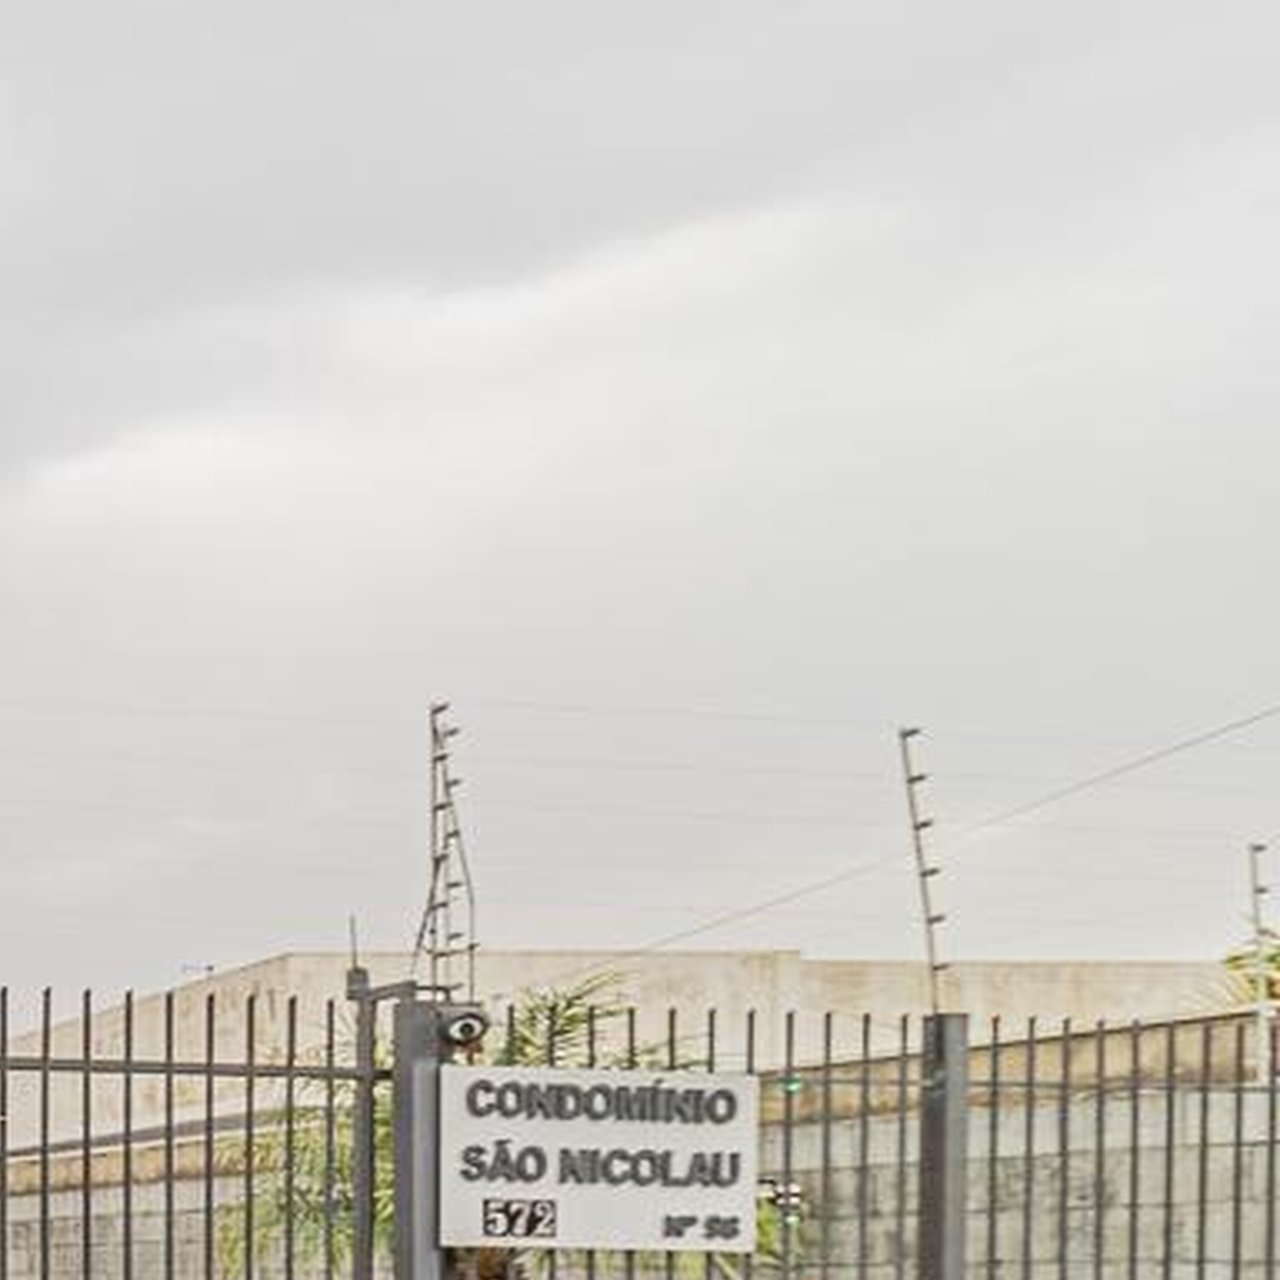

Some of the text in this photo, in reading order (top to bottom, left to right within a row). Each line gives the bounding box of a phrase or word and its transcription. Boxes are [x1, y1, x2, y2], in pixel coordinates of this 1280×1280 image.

[466, 1079, 738, 1124] CONDOMÍNIO
[460, 1139, 740, 1188] SÃO NICOLAU
[484, 1200, 555, 1237] 572
